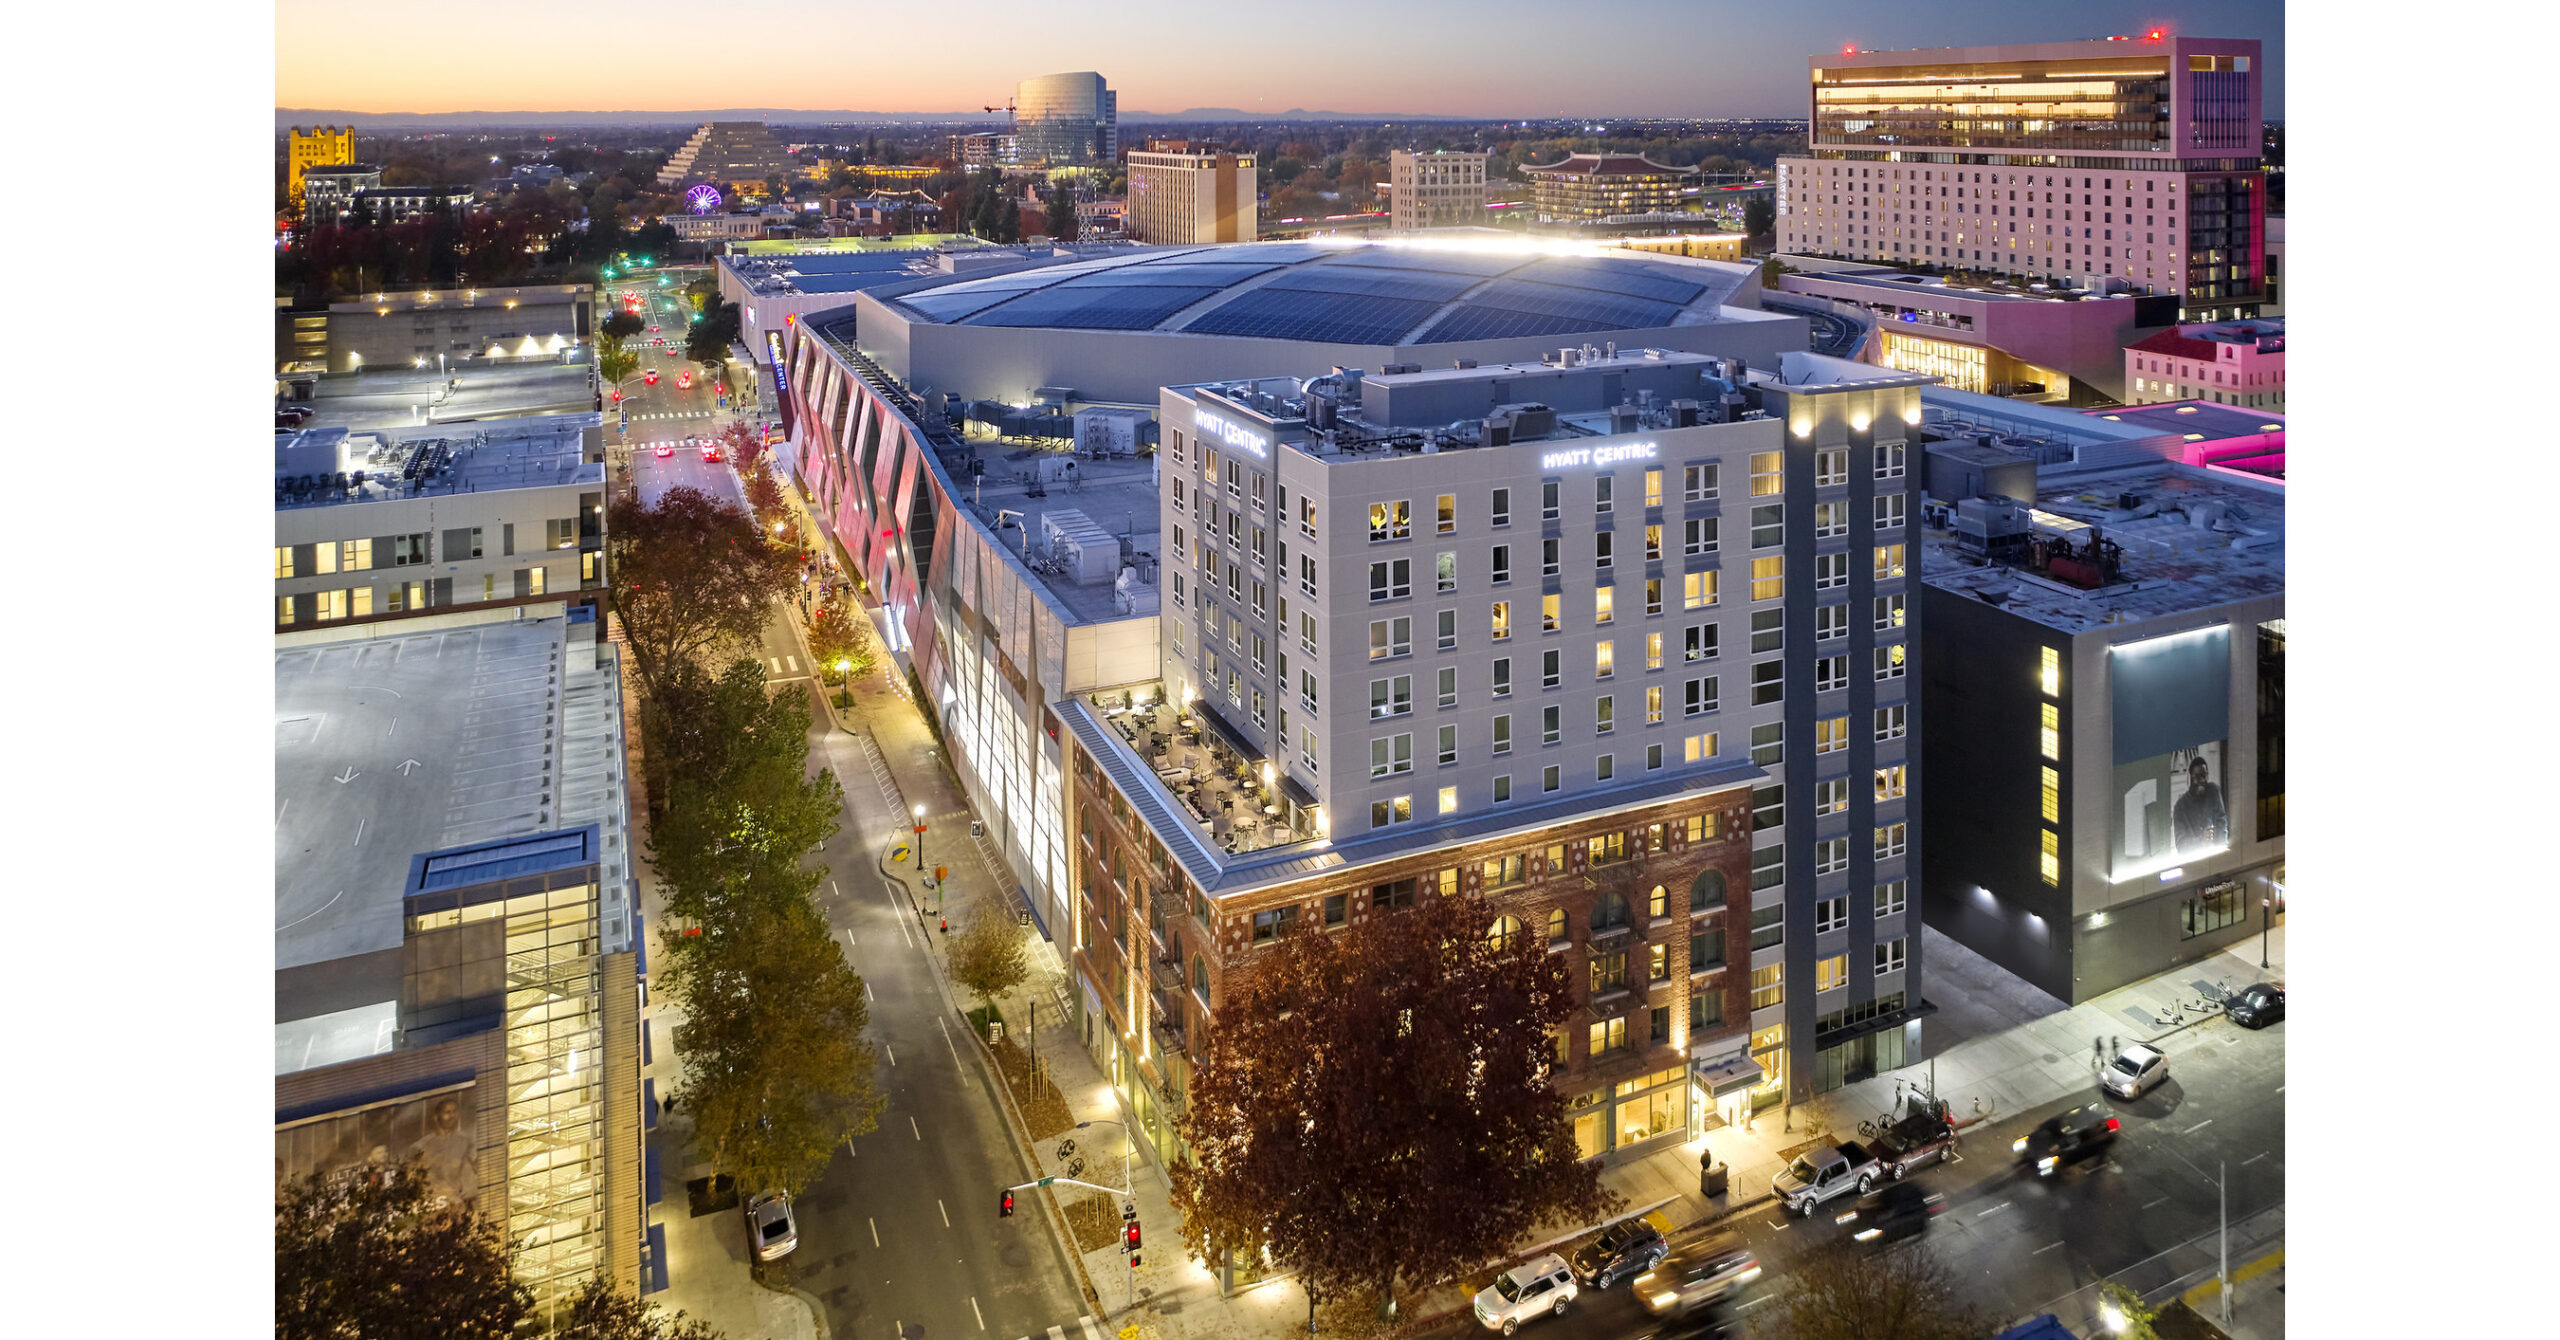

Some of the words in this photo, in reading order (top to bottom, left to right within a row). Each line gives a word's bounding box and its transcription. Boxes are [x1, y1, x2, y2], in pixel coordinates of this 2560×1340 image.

[776, 363, 787, 391] CENTER
[1195, 408, 1225, 437] HYATT
[1225, 421, 1267, 458] CENTRIC
[1543, 449, 1591, 469] HYATT
[1593, 442, 1657, 465] CENTRIC
